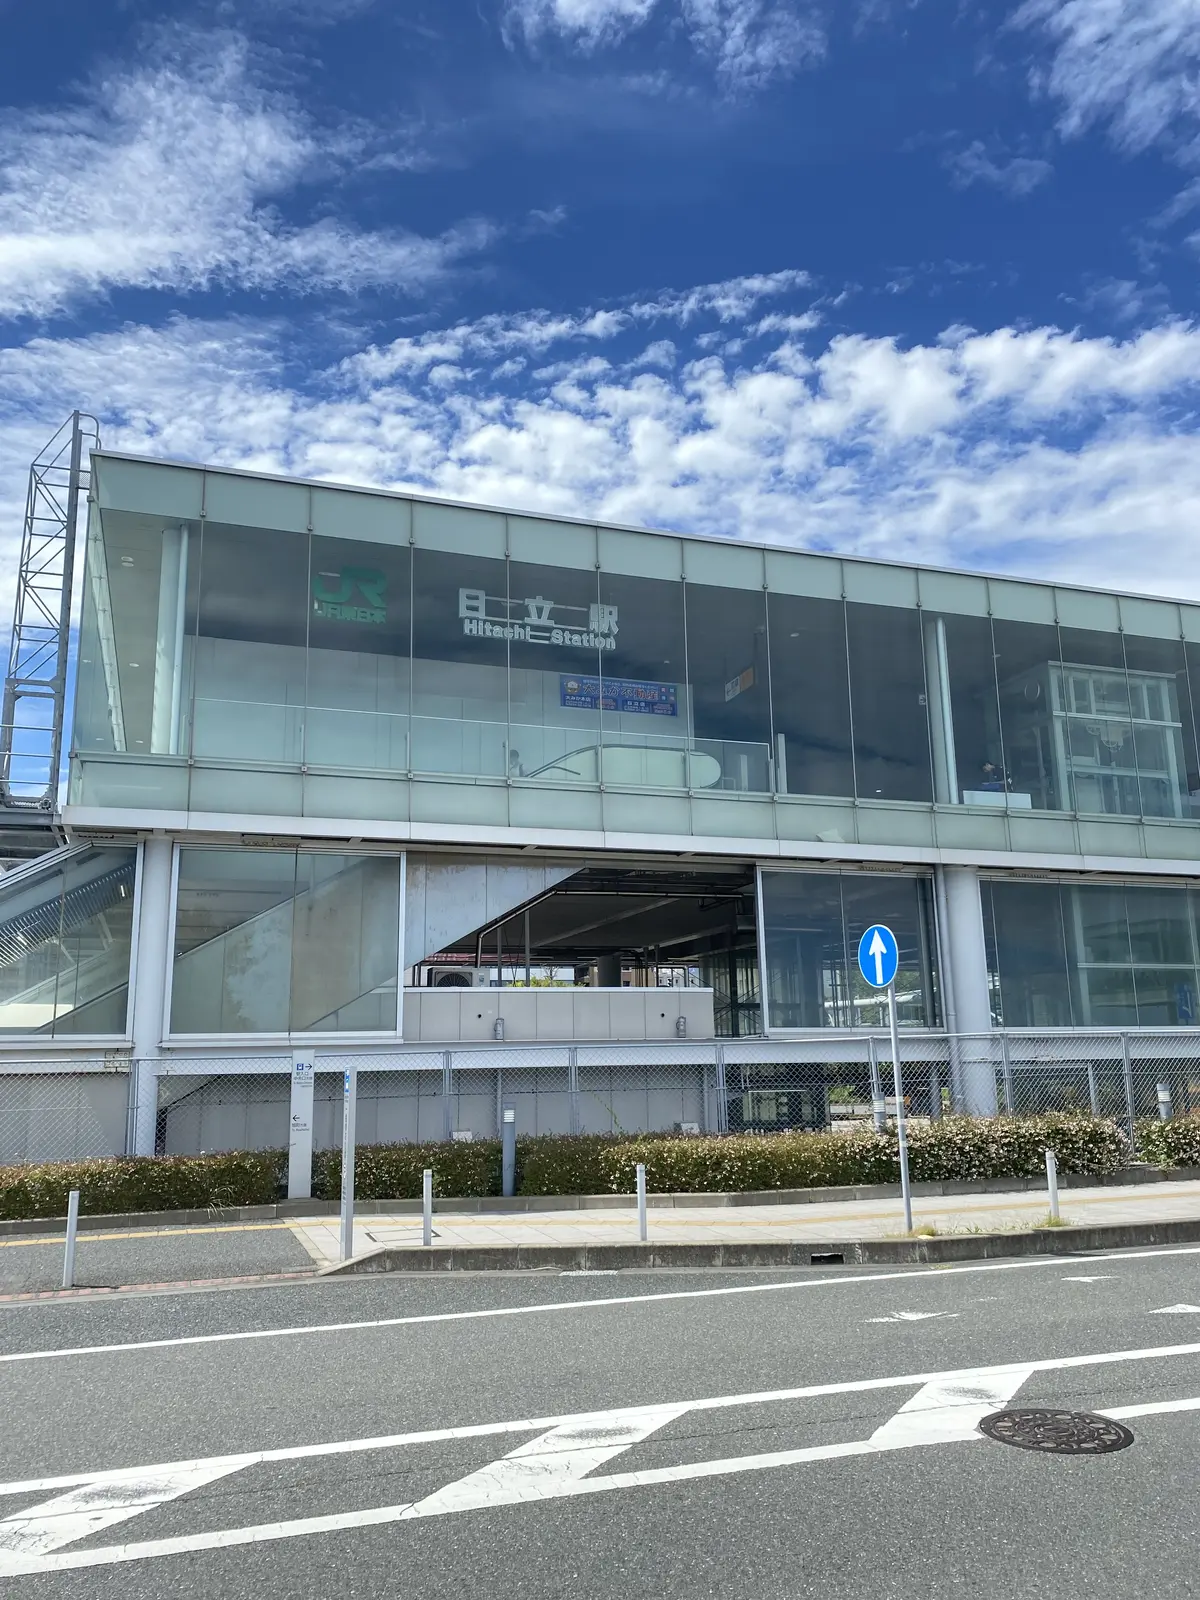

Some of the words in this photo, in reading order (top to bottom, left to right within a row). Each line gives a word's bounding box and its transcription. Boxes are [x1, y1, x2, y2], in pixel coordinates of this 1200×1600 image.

[313, 566, 387, 607] JR
[459, 587, 619, 635] 日立駅
[464, 618, 531, 641] Hitachi
[551, 628, 616, 650] Station
